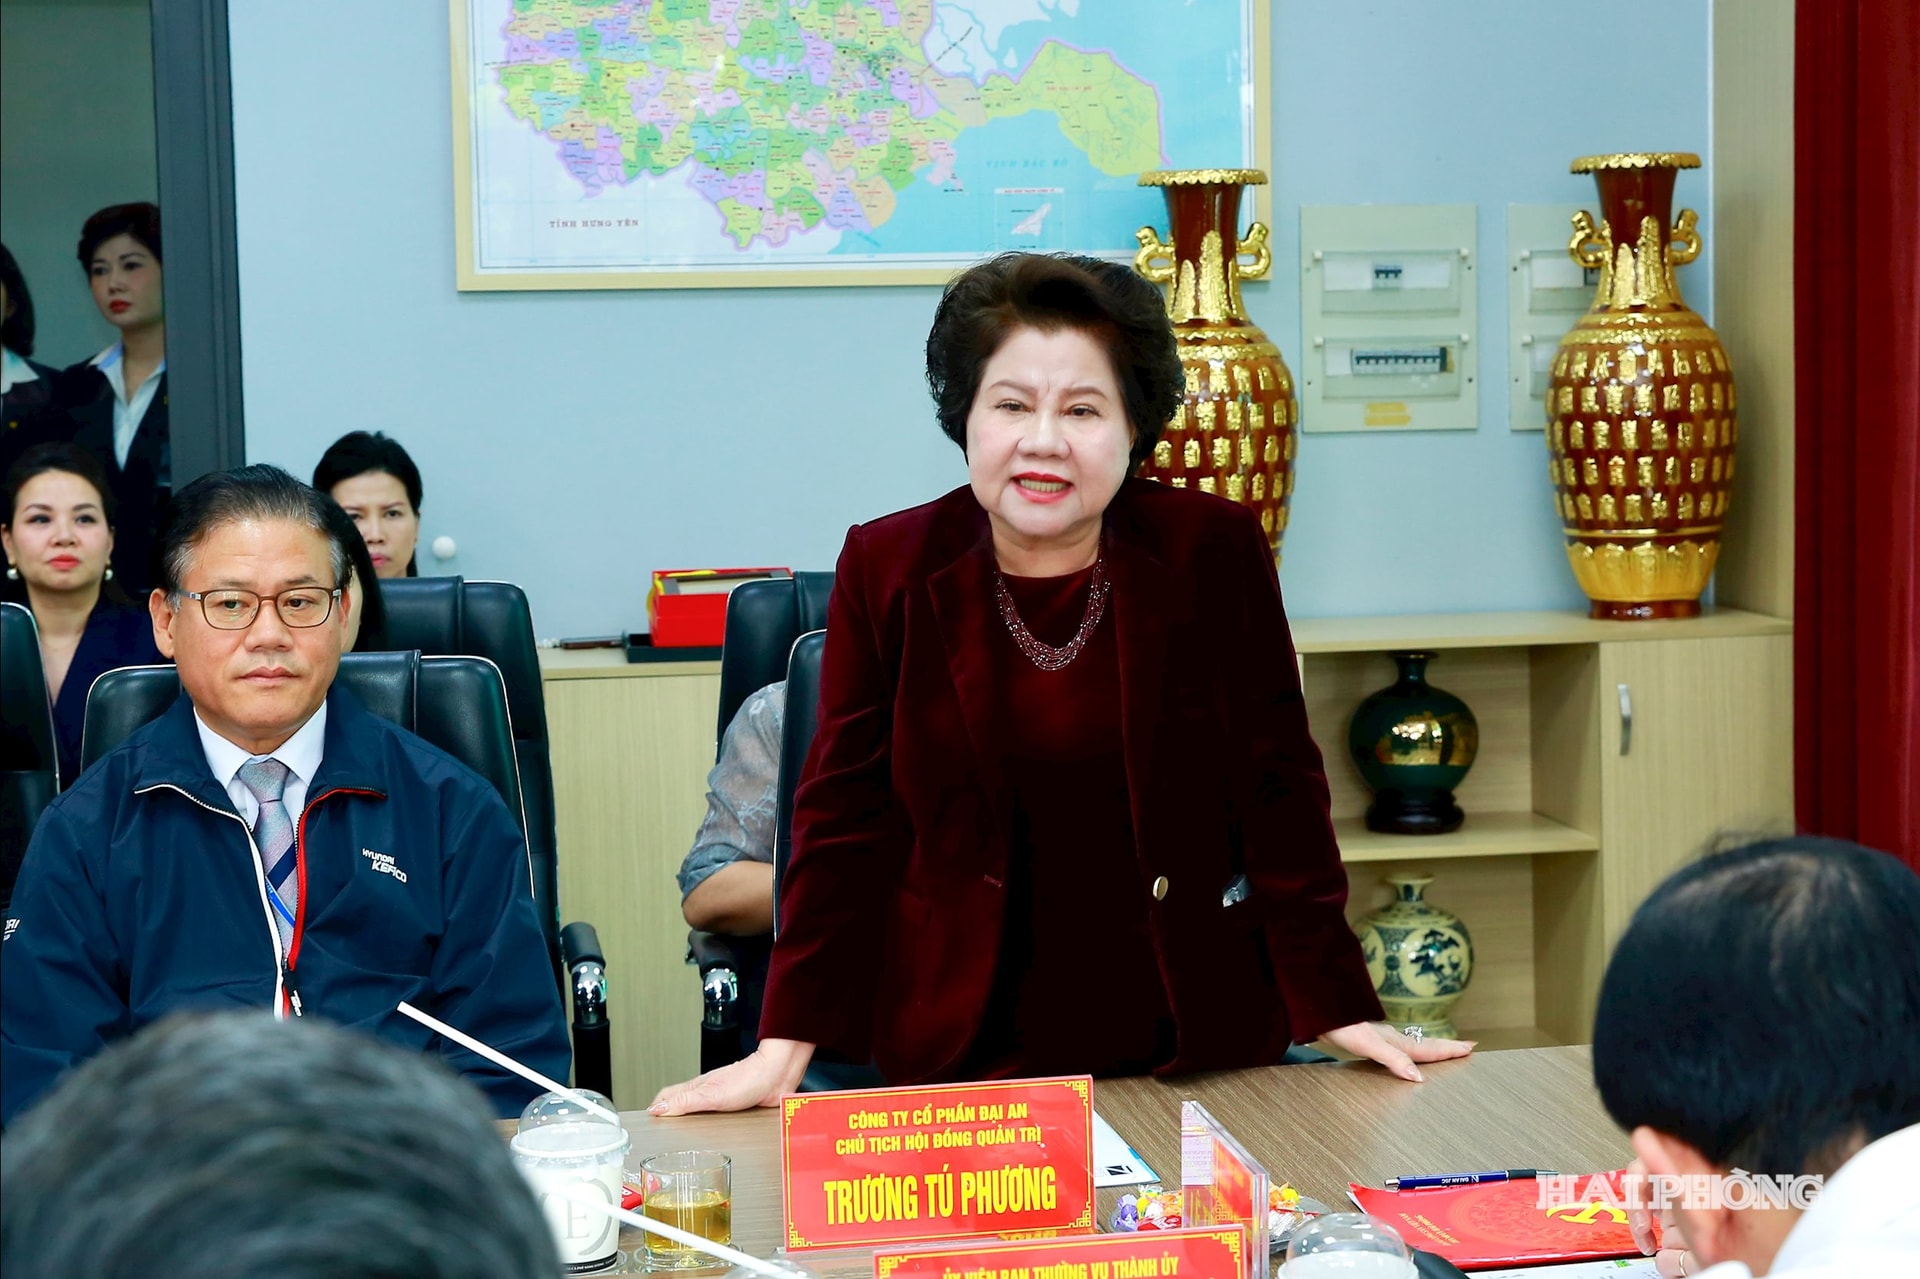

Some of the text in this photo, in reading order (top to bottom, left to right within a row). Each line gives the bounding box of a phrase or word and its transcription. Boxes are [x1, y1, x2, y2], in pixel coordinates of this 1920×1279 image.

[549, 217, 639, 228] TỈNH HƯNG YÊN
[362, 848, 395, 864] HYUNDAI
[371, 860, 407, 883] KEFICO
[848, 1110, 888, 1130] CÔNG
[892, 1111, 908, 1127] TY
[912, 1103, 933, 1126] CỔ
[979, 1104, 1004, 1123] ĐẠI
[1007, 1102, 1028, 1120] AN
[835, 1133, 865, 1155] CHỦ
[869, 1135, 901, 1156] TỊCH
[905, 1131, 929, 1153] HỘI
[976, 1124, 1015, 1148] QUẢN
[1019, 1126, 1042, 1145] TRỊ
[823, 1163, 1057, 1225] TRƯƠNG TÚ PHƯƠNG
[1032, 1260, 1087, 1279] THƯỜNG
[1112, 1256, 1157, 1279] THÀNH
[1161, 1251, 1179, 1275] ỦY
